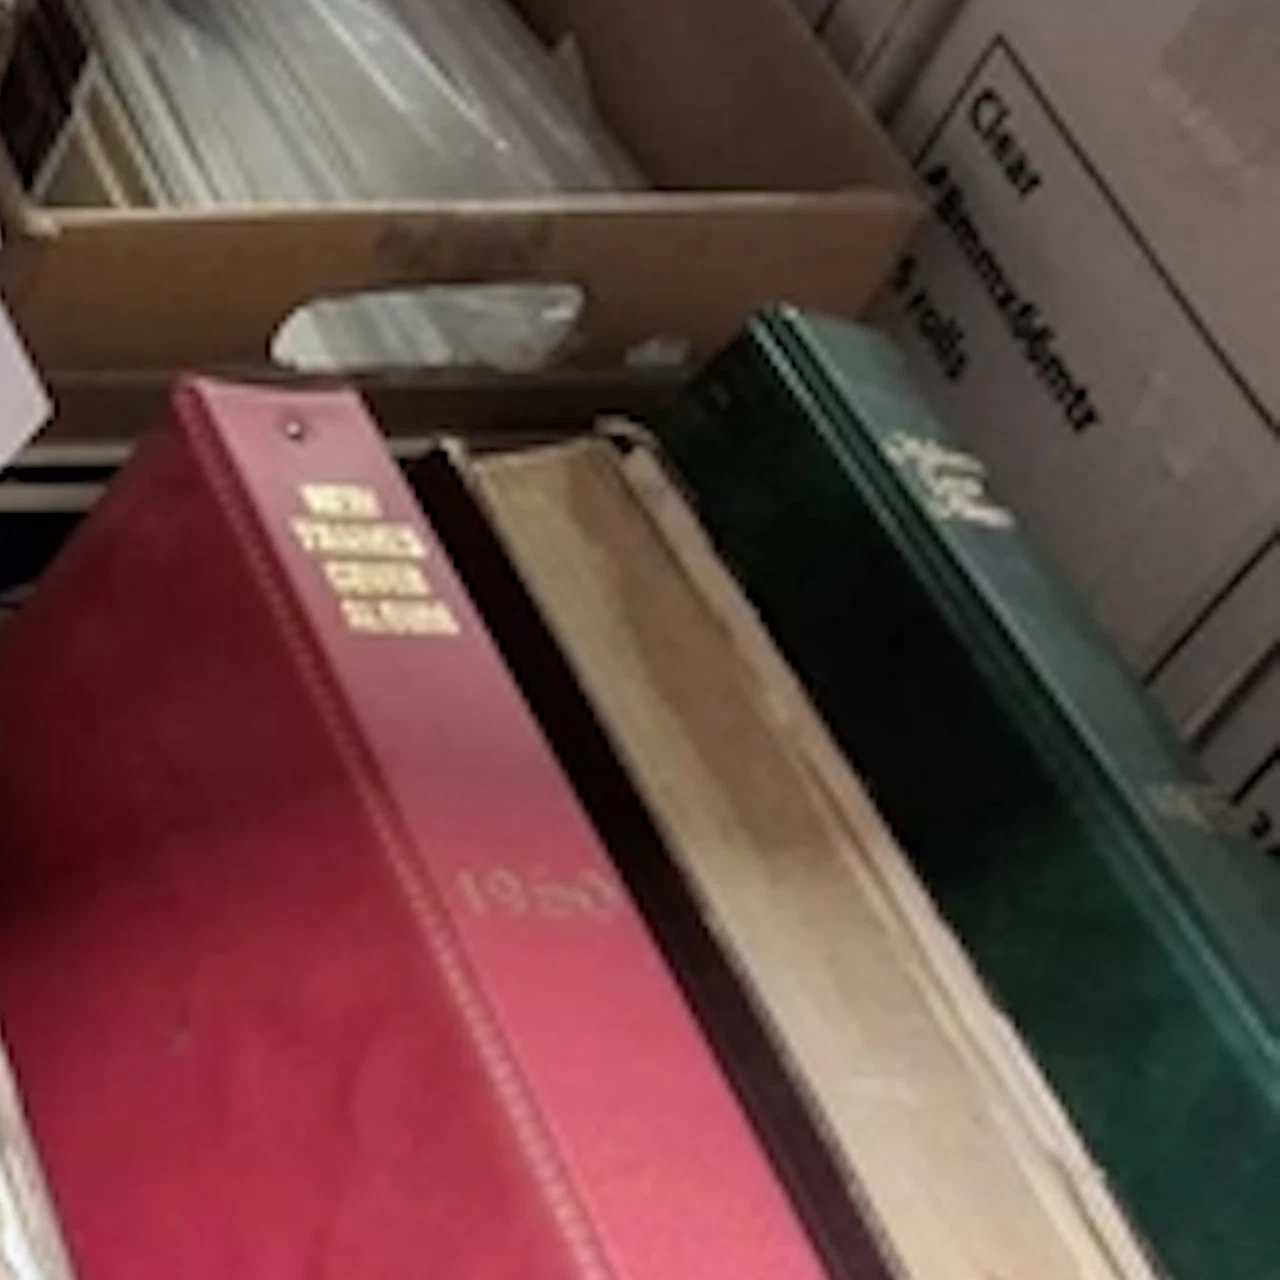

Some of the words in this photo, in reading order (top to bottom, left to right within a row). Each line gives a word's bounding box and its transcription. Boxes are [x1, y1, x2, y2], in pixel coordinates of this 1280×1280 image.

[970, 85, 1043, 201] Clear
[300, 483, 384, 519] NEW
[324, 559, 432, 598] COVER
[340, 596, 462, 639] ALBUM
